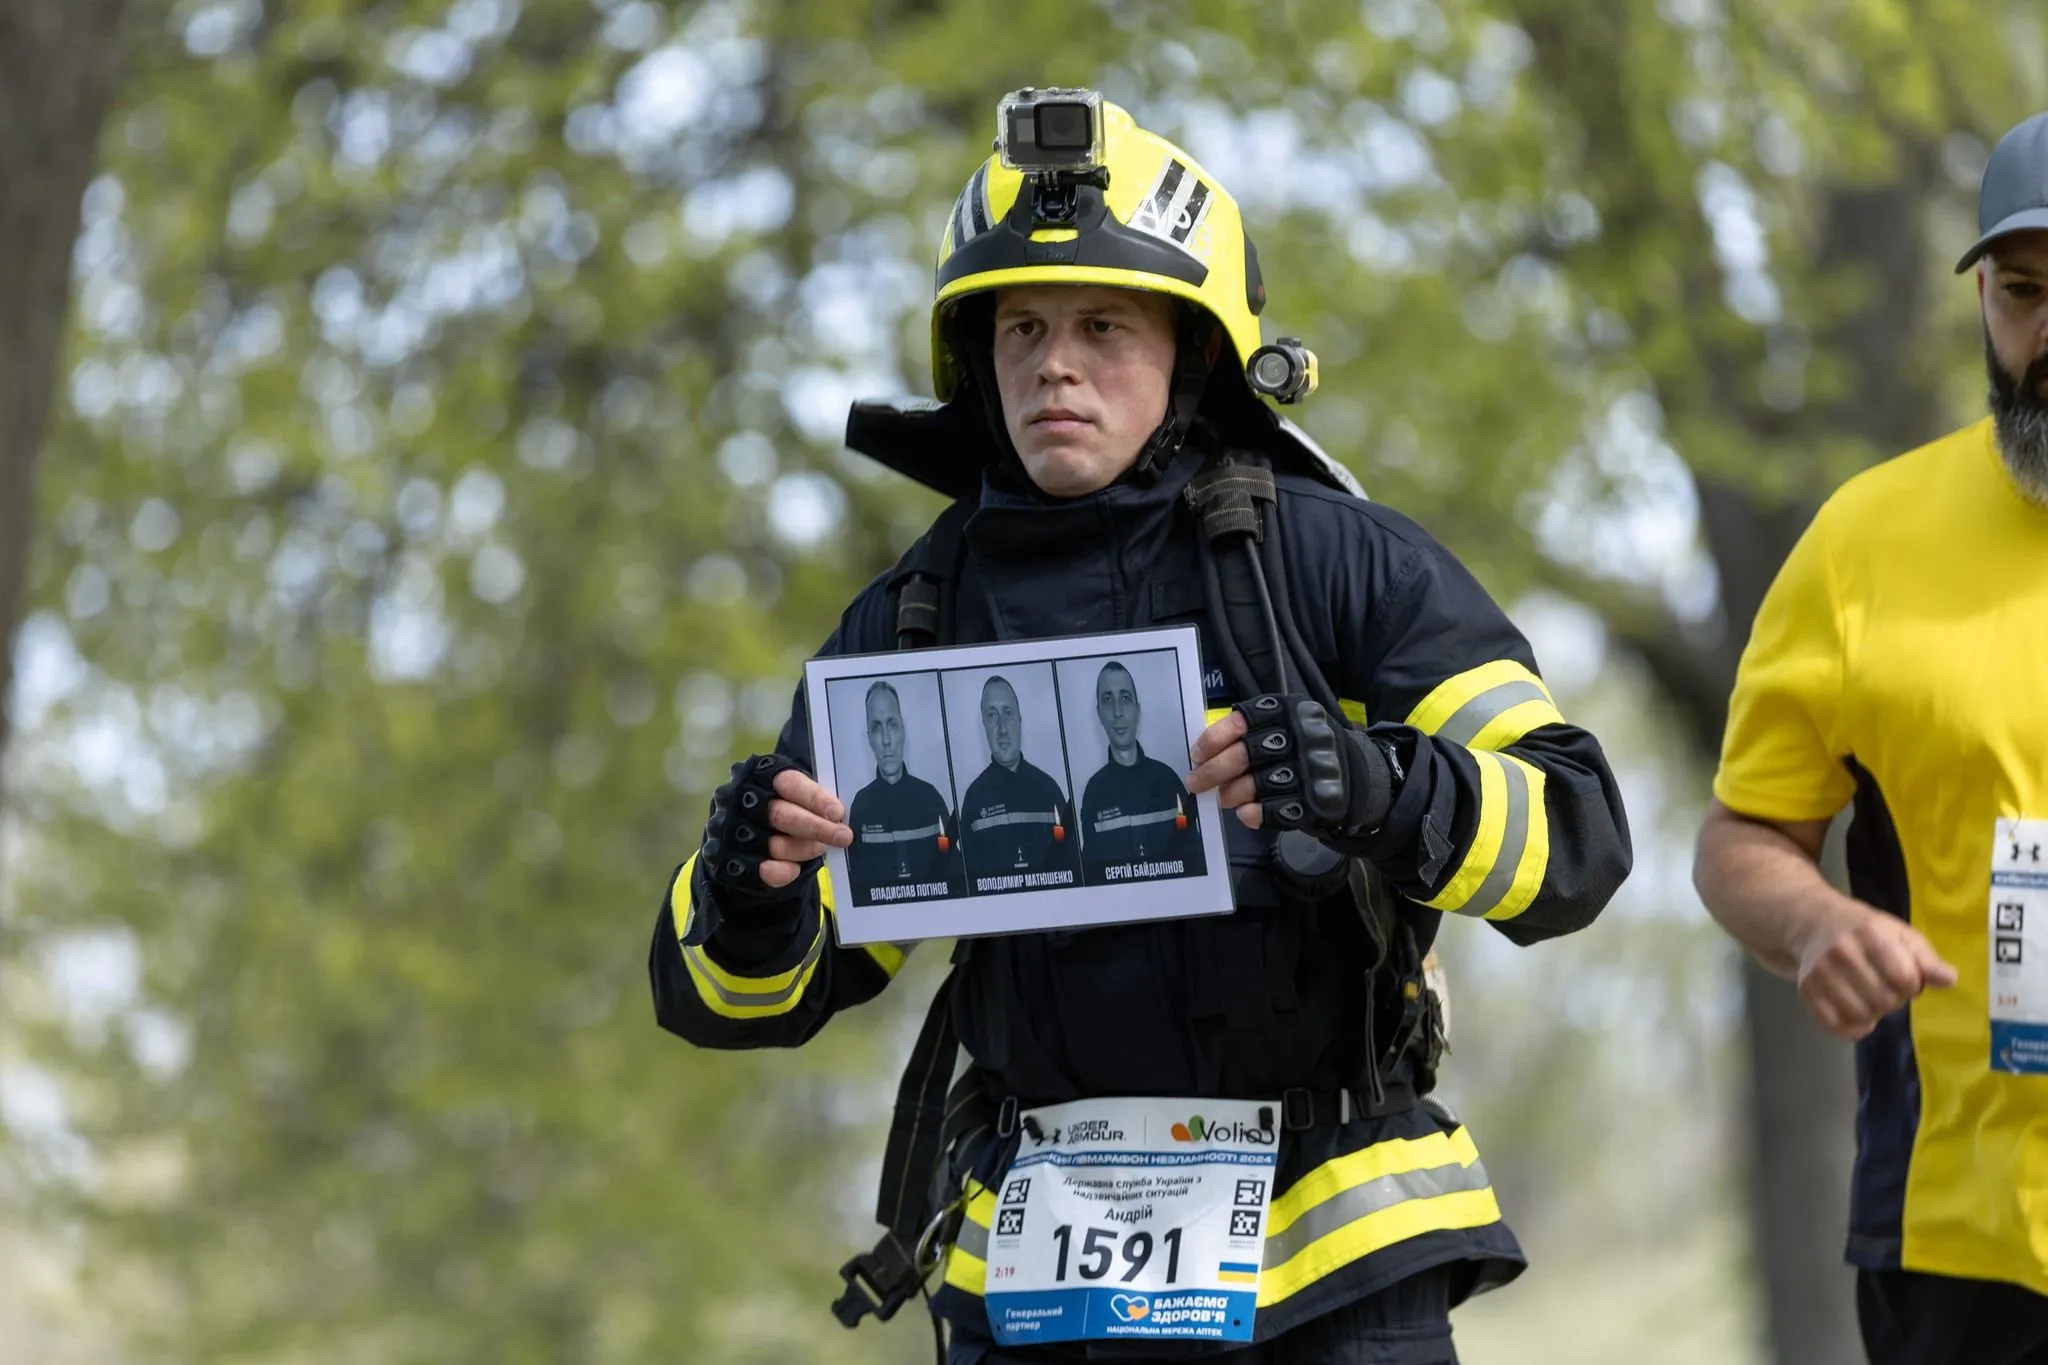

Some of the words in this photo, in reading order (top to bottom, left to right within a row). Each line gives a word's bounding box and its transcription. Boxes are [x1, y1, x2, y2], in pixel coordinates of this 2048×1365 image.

[1105, 863, 1133, 880] СЕРГІЙ
[1133, 860, 1185, 878] БАЙДАЛІНОВ
[977, 875, 1024, 891] ВОЛОДИМИР
[1024, 870, 1074, 887] МАТЮШЕНКО
[870, 884, 916, 901] ВЛАДИСЛАВ
[916, 882, 948, 897] ЛОГІНОВ
[1067, 1120, 1109, 1136] UNDER
[1067, 1130, 1124, 1144] ARMOUR
[1239, 1154, 1272, 1164] 2024
[1115, 1175, 1152, 1192] служба
[1156, 1175, 1194, 1187] України
[1145, 1187, 1189, 1199] ситуацій
[1104, 1204, 1153, 1224] Андрій
[1053, 1224, 1182, 1284] 1591
[995, 1266, 1016, 1278] 2:19
[1154, 1296, 1228, 1309] БАЖАЄМО
[1005, 1305, 1063, 1320] Генеральний
[1151, 1309, 1226, 1324] ЗДОРОВ'Я
[1005, 1320, 1041, 1332] партнер
[1106, 1326, 1160, 1335] НАЦІОНАЛЬНА
[1161, 1327, 1194, 1336] МЕРЕЖА
[1195, 1328, 1223, 1337] АПТЕК
